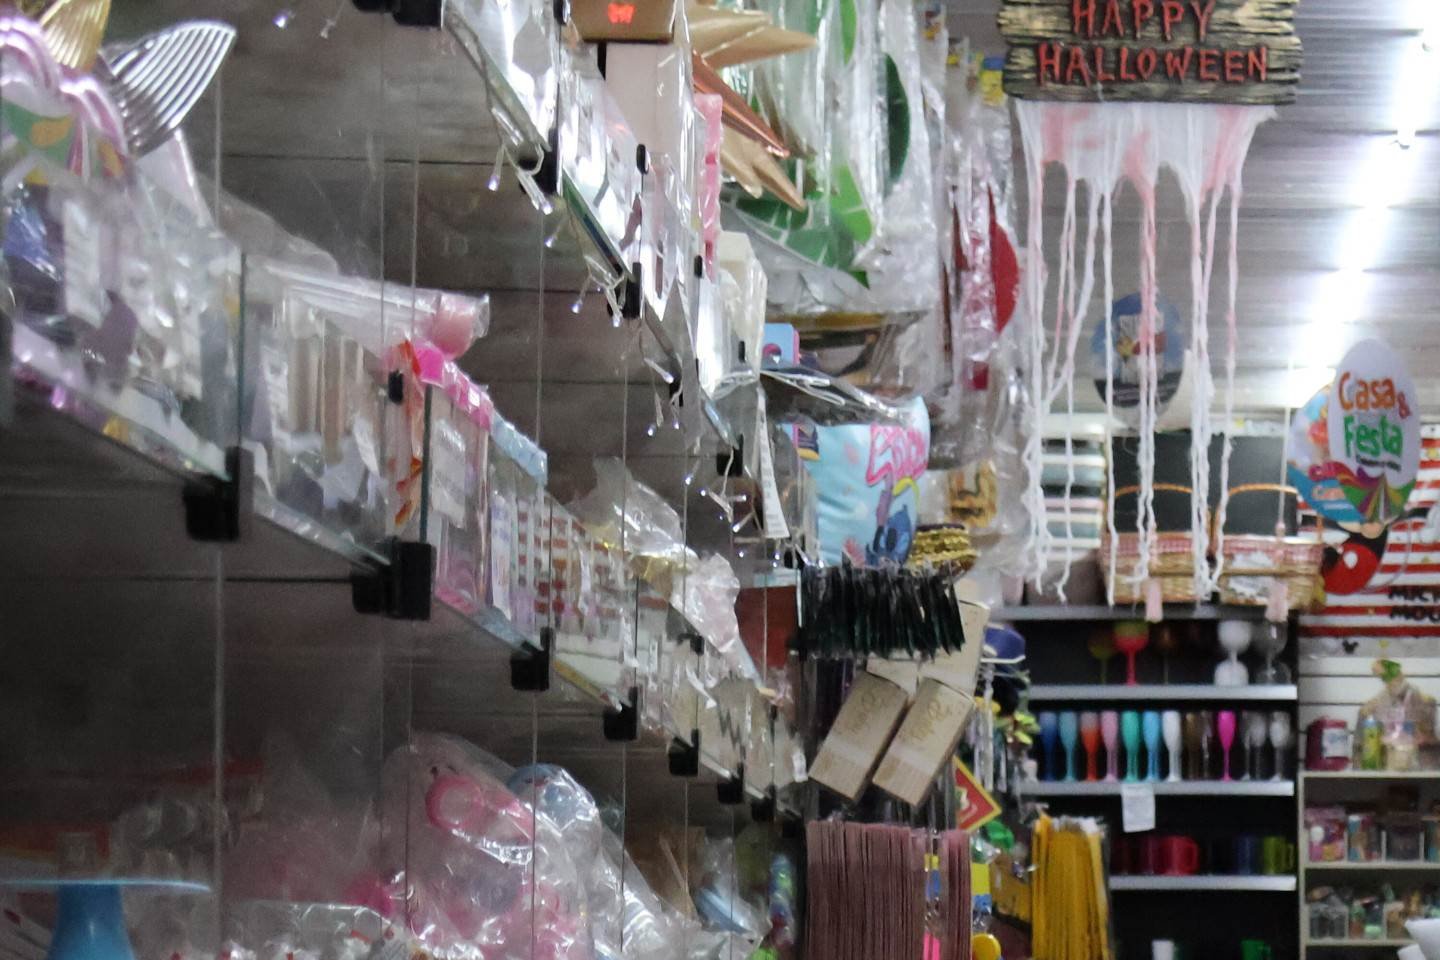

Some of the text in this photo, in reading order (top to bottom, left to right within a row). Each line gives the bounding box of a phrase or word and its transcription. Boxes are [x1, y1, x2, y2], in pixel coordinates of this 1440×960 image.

[1071, 0, 1216, 41] HAPPY
[1037, 41, 1269, 88] HALLOWEEN
[1338, 370, 1396, 412] Casa
[1343, 414, 1404, 459] Festa
